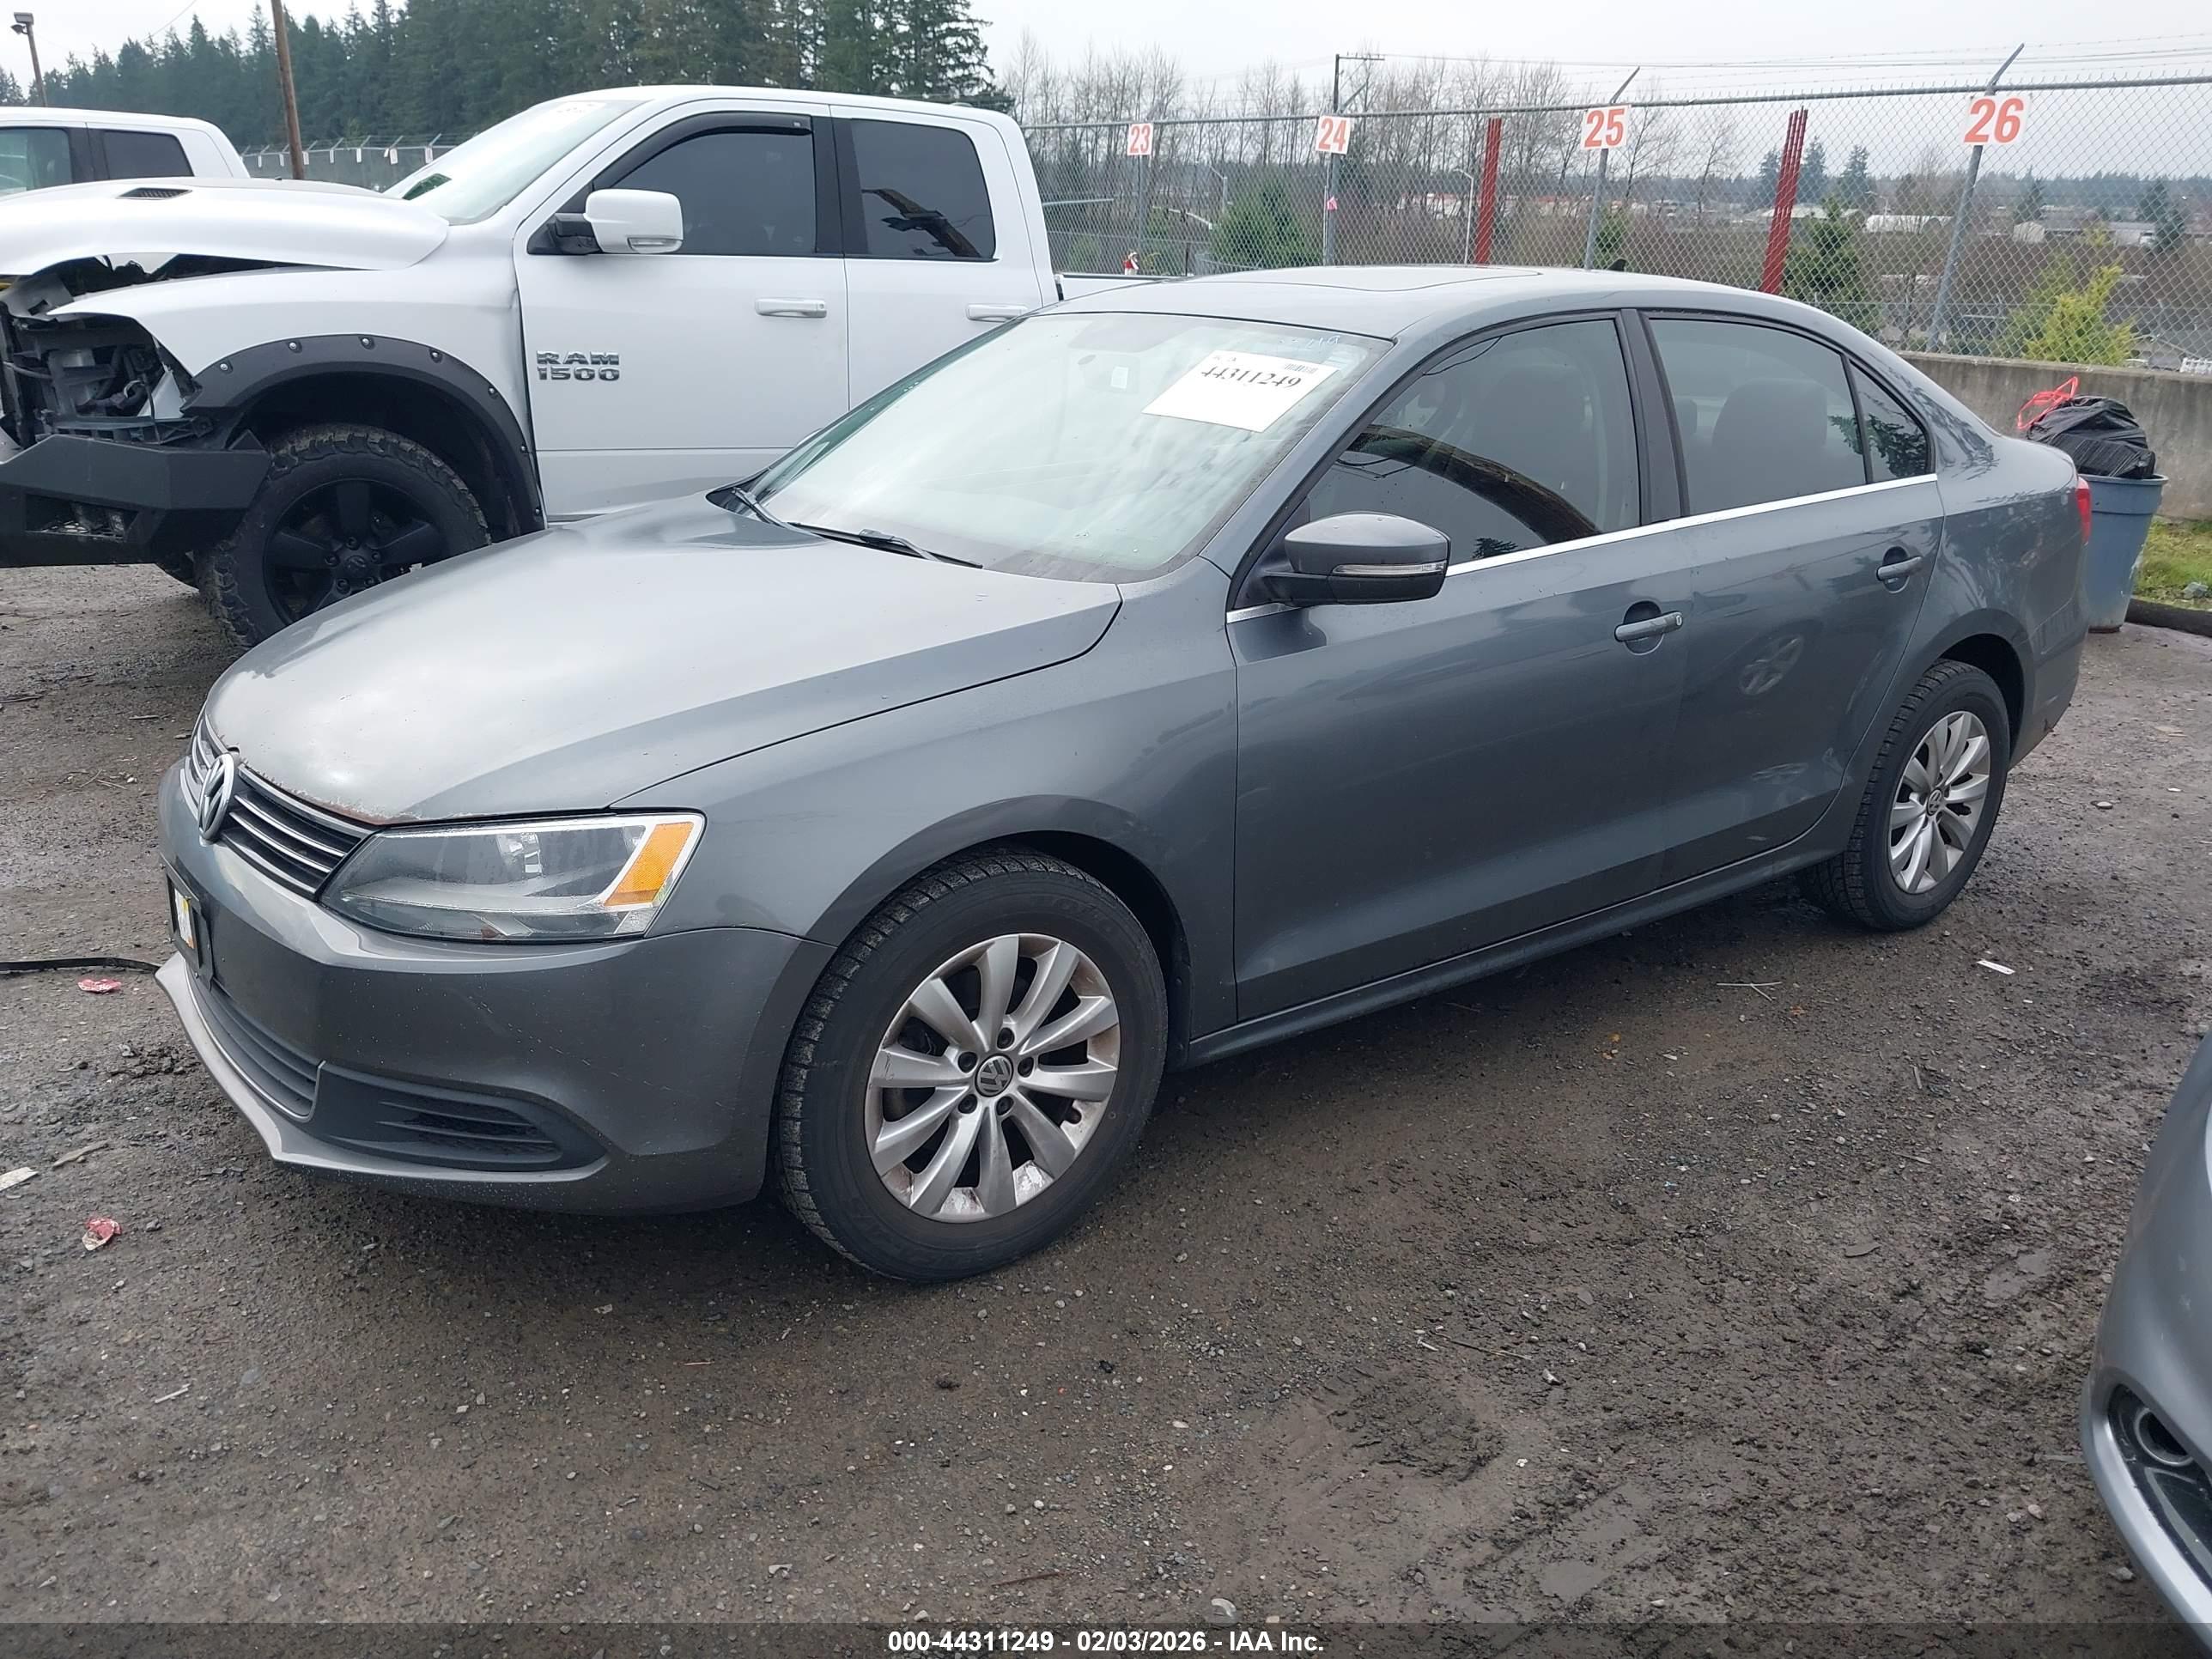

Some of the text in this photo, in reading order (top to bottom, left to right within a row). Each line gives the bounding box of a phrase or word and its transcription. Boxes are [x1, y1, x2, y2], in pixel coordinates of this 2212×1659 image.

[1584, 108, 1626, 148] 25
[1964, 97, 2024, 143] 26
[1130, 125, 1151, 154] 23
[1318, 118, 1346, 152] 24
[536, 350, 620, 365] RAM
[537, 366, 620, 381] 1500
[1200, 365, 1302, 388] 44311249
